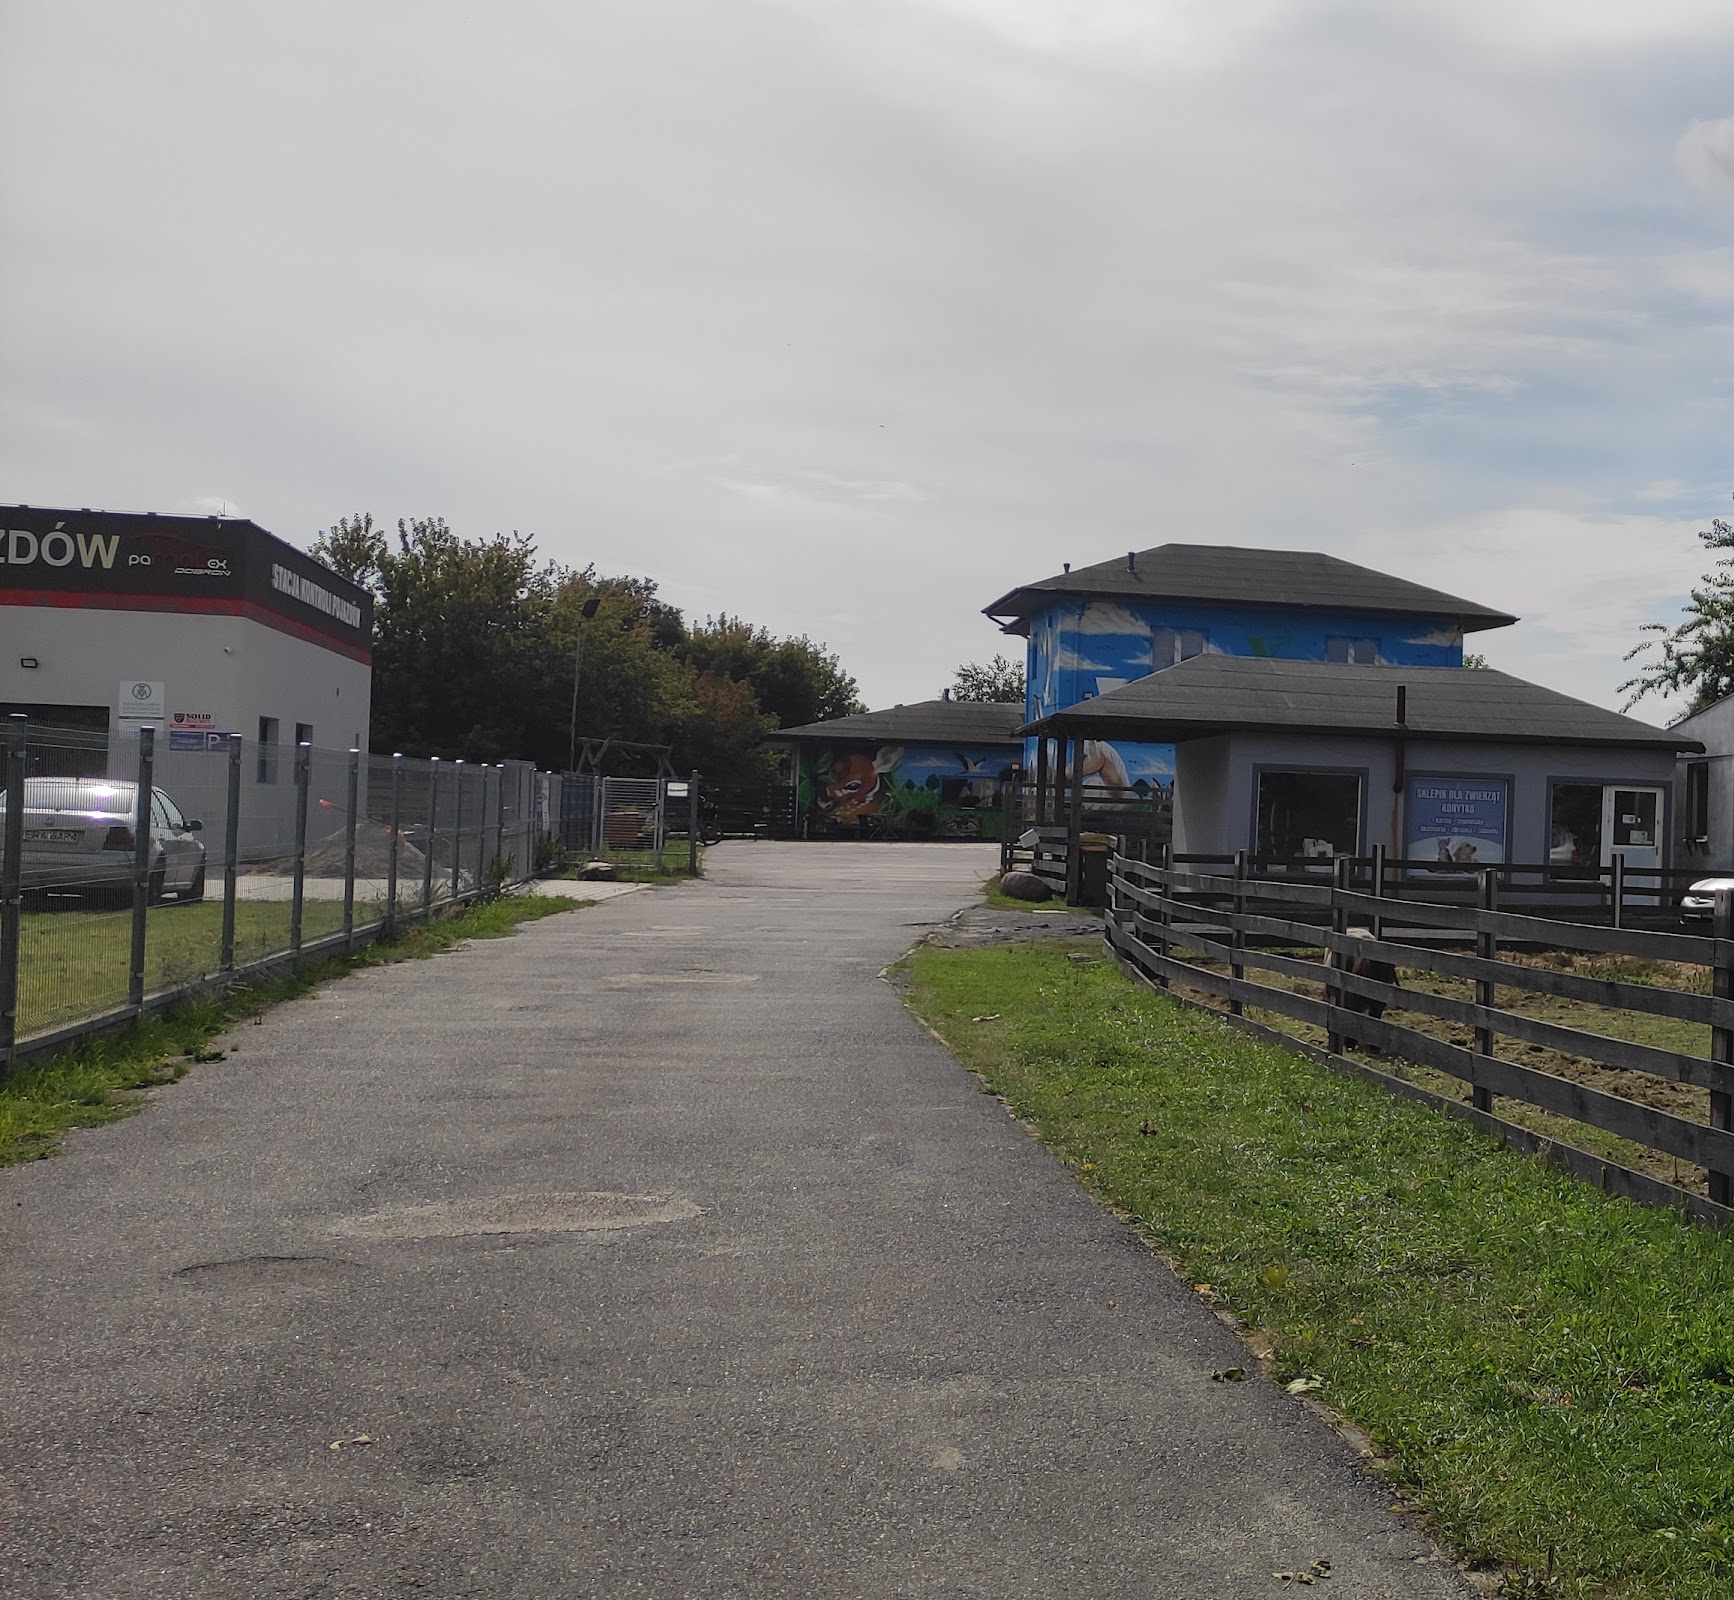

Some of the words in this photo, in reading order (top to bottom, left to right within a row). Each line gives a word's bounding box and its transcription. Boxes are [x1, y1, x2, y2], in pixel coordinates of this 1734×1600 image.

[0, 522, 120, 569] DÓW
[272, 563, 300, 600] STACJA
[1417, 788, 1447, 799] SKLEPIK
[1449, 789, 1463, 800] DLA
[1465, 791, 1501, 804] ZWIERZĄT
[1441, 803, 1475, 814] KORYTKO
